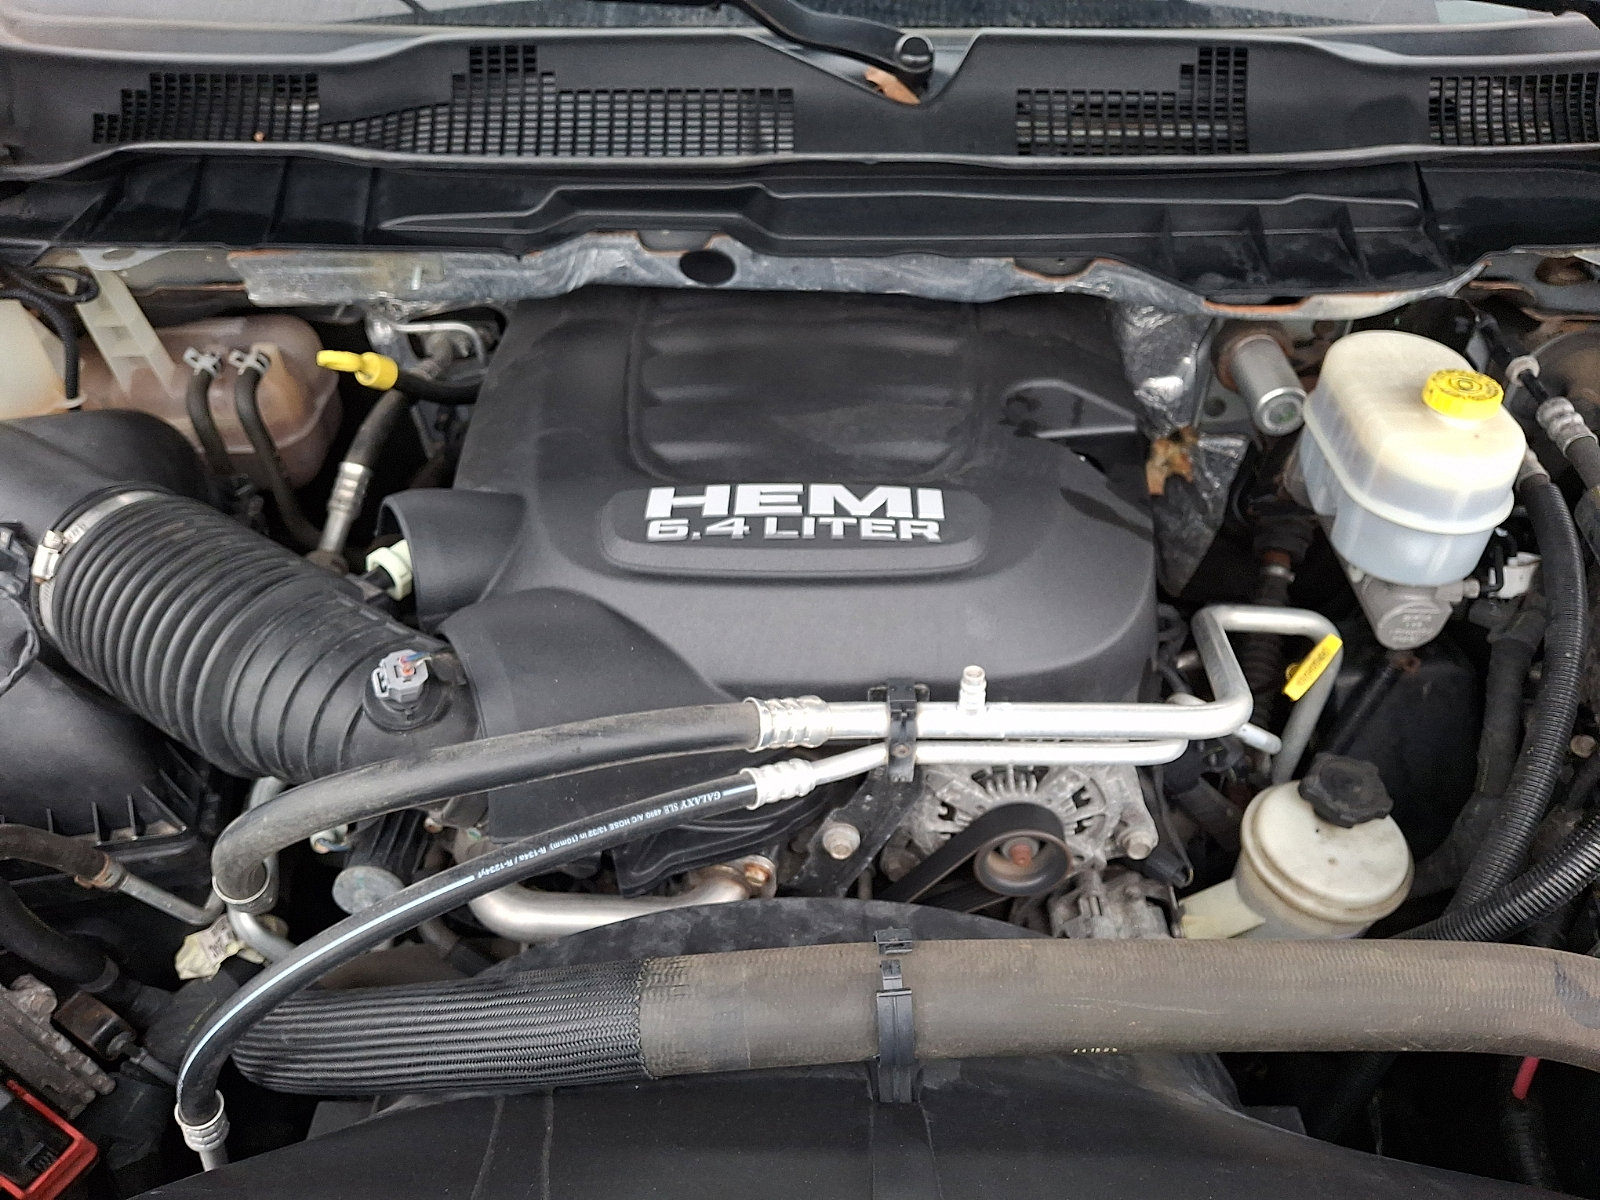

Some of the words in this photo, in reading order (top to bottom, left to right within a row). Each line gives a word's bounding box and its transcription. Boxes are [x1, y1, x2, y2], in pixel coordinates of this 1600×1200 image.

[646, 483, 945, 519] HEMI
[647, 517, 750, 541] 6.4
[764, 516, 943, 542] LITER
[680, 791, 721, 810] GALAXY
[663, 803, 679, 815] SLE
[609, 818, 631, 831] HOSE
[632, 813, 644, 824] A/C
[579, 832, 588, 840] in
[588, 825, 608, 838] 13/32
[549, 833, 579, 850] (10mm)
[519, 846, 547, 861] R-134a
[477, 858, 513, 879] R-1234yf
